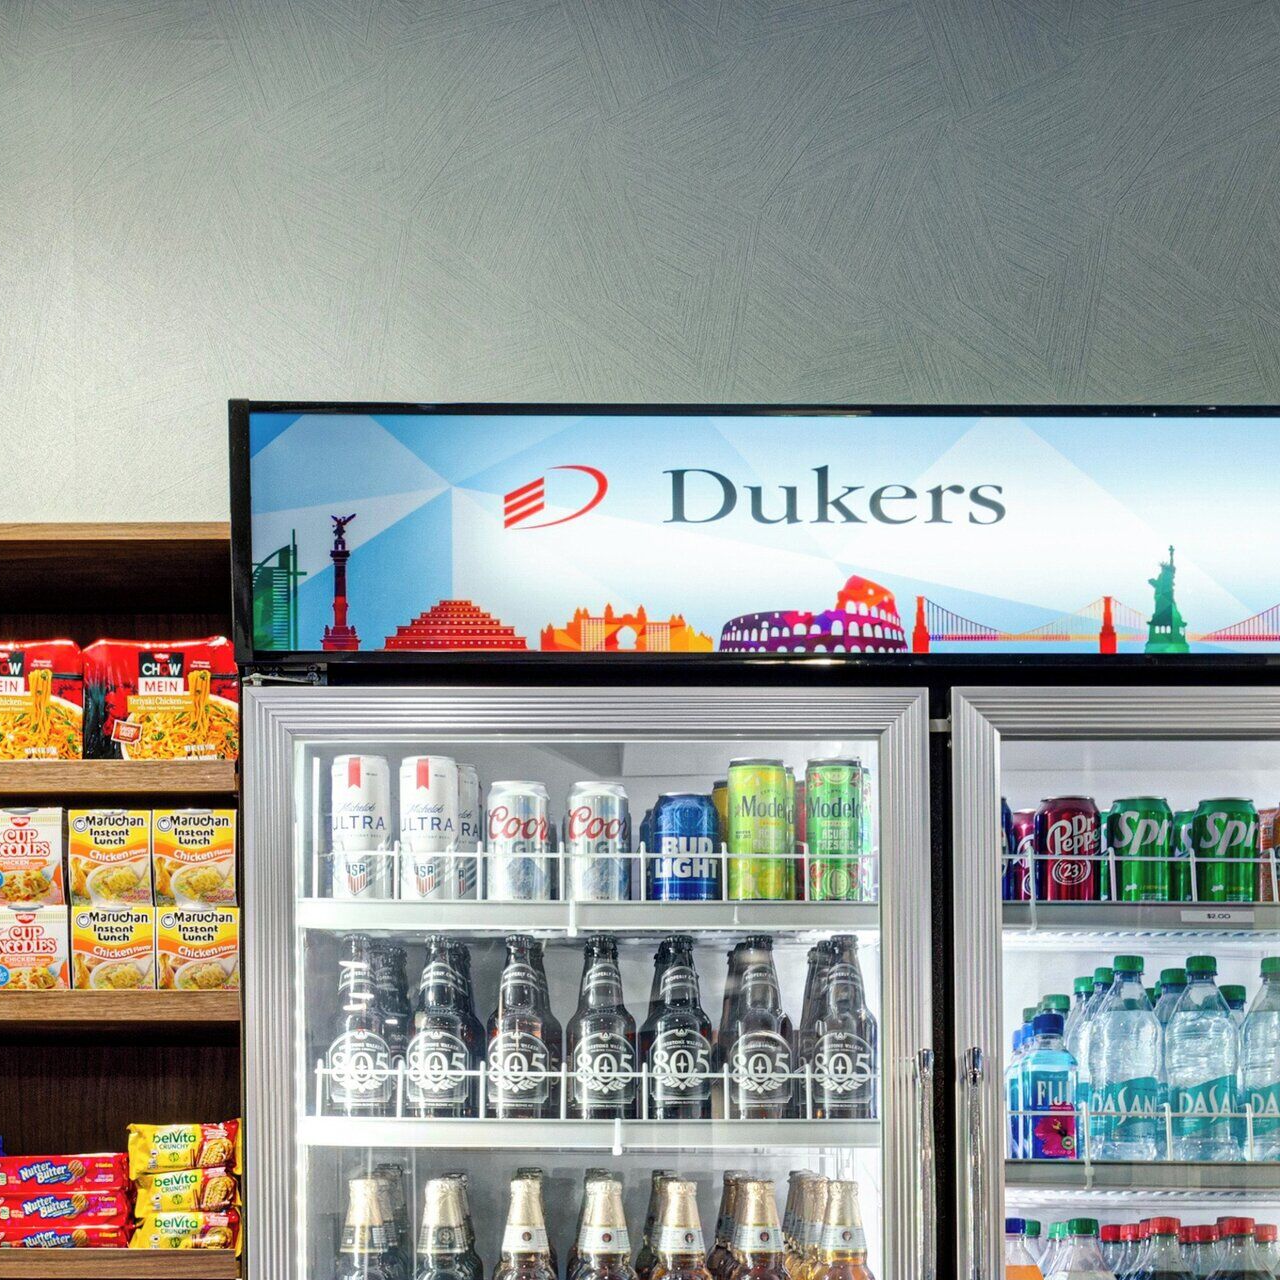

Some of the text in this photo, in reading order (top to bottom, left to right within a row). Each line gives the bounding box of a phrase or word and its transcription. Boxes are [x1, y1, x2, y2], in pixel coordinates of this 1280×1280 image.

[662, 465, 1006, 525] Dukers
[142, 662, 180, 676] CHOW
[145, 681, 178, 692] MEIN
[86, 816, 143, 826] Maruchan
[171, 816, 228, 826] Maruchan
[1073, 815, 1095, 836] Dr
[3, 829, 38, 843] CUP
[90, 828, 129, 836] Instant
[663, 837, 713, 854] BUD
[90, 850, 128, 861] Chicken
[174, 850, 213, 861] Chicken
[655, 858, 717, 878] LIGHT
[1064, 864, 1078, 876] 23
[89, 912, 148, 922] Maruchan
[174, 912, 232, 922] Maruchan
[9, 926, 44, 940] CUP
[98, 933, 129, 941] Lunch
[94, 946, 133, 957] Chicken
[178, 946, 217, 957] Chicken
[489, 1053, 546, 1081] 805
[653, 1050, 710, 1080] 805
[732, 1053, 790, 1082] 805
[815, 1053, 870, 1082] 805
[1037, 1081, 1071, 1106] FIJI
[153, 1134, 196, 1143] belVita
[21, 1162, 51, 1178] Nutter
[37, 1167, 66, 1183] Butter
[155, 1175, 198, 1187] belVita
[161, 1184, 191, 1193] CRUNCHY
[23, 1196, 54, 1214] Nutter
[41, 1200, 70, 1217] Butter
[155, 1218, 198, 1229] belVita
